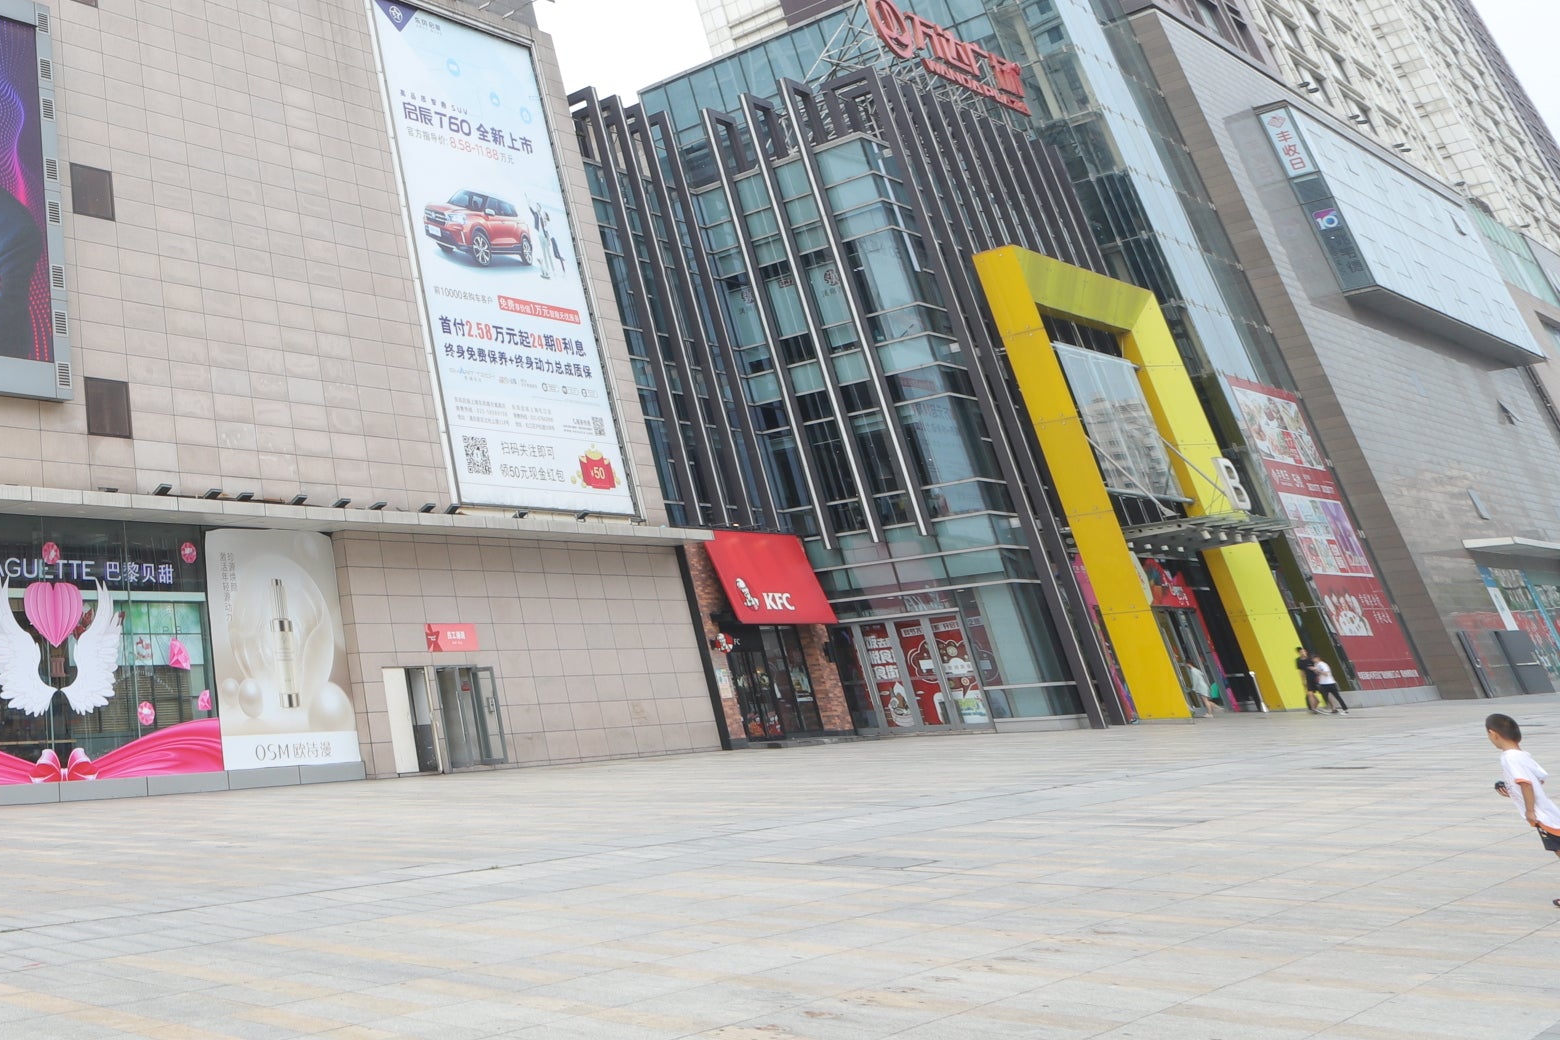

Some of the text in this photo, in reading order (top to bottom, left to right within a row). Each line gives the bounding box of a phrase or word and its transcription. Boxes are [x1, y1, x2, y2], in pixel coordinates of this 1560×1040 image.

[920, 58, 983, 95] WANDA
[402, 102, 534, 155] 启辰T60 全新上市
[1276, 130, 1306, 171] 丰收日
[439, 315, 587, 357] 首付2.58万元起24期0利息
[444, 343, 592, 378] 终身免费保养+终身动力总成质保
[501, 442, 555, 459] 扫码关注即可
[500, 464, 565, 483] 领50元现金红包
[106, 562, 175, 585] 巴黎贝甜
[762, 592, 795, 610] KFC
[255, 741, 332, 761] OSM 欧诗漫
